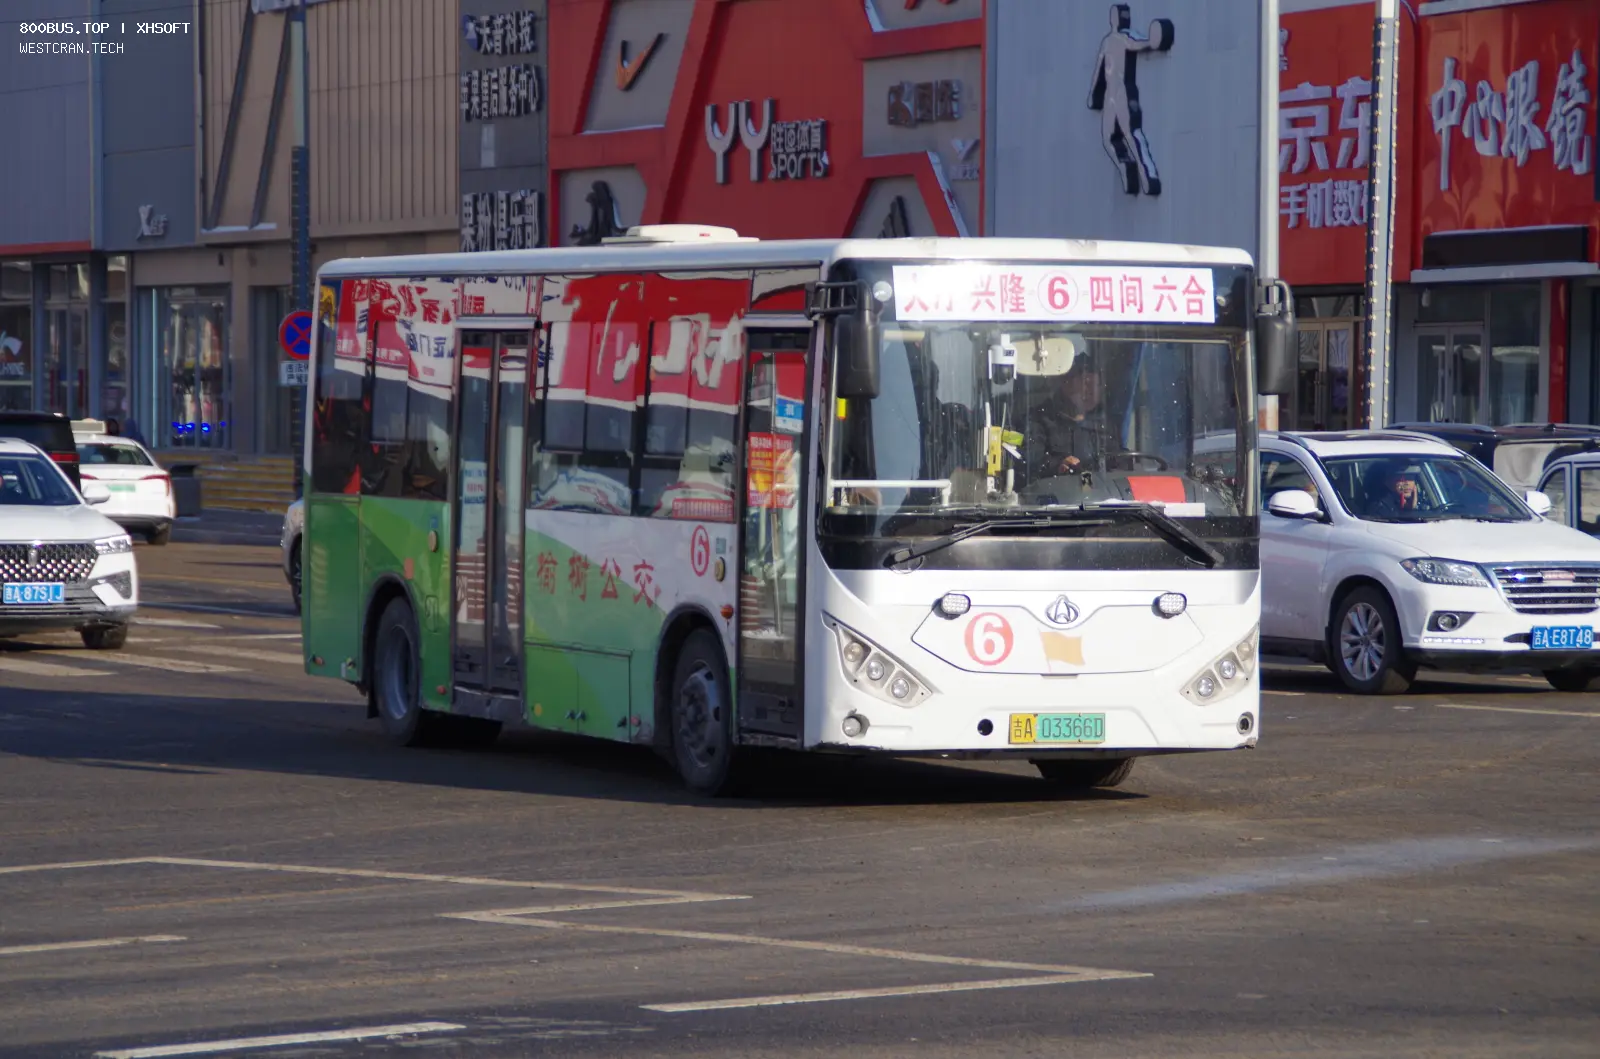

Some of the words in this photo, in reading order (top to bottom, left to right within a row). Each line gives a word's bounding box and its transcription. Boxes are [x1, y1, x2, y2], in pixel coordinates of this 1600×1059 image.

[705, 97, 773, 184] YY
[1279, 76, 1371, 175] 京东
[1431, 49, 1592, 191] 中心眼镜
[1279, 178, 1369, 228] 手机数
[1089, 274, 1207, 316] 四间六合
